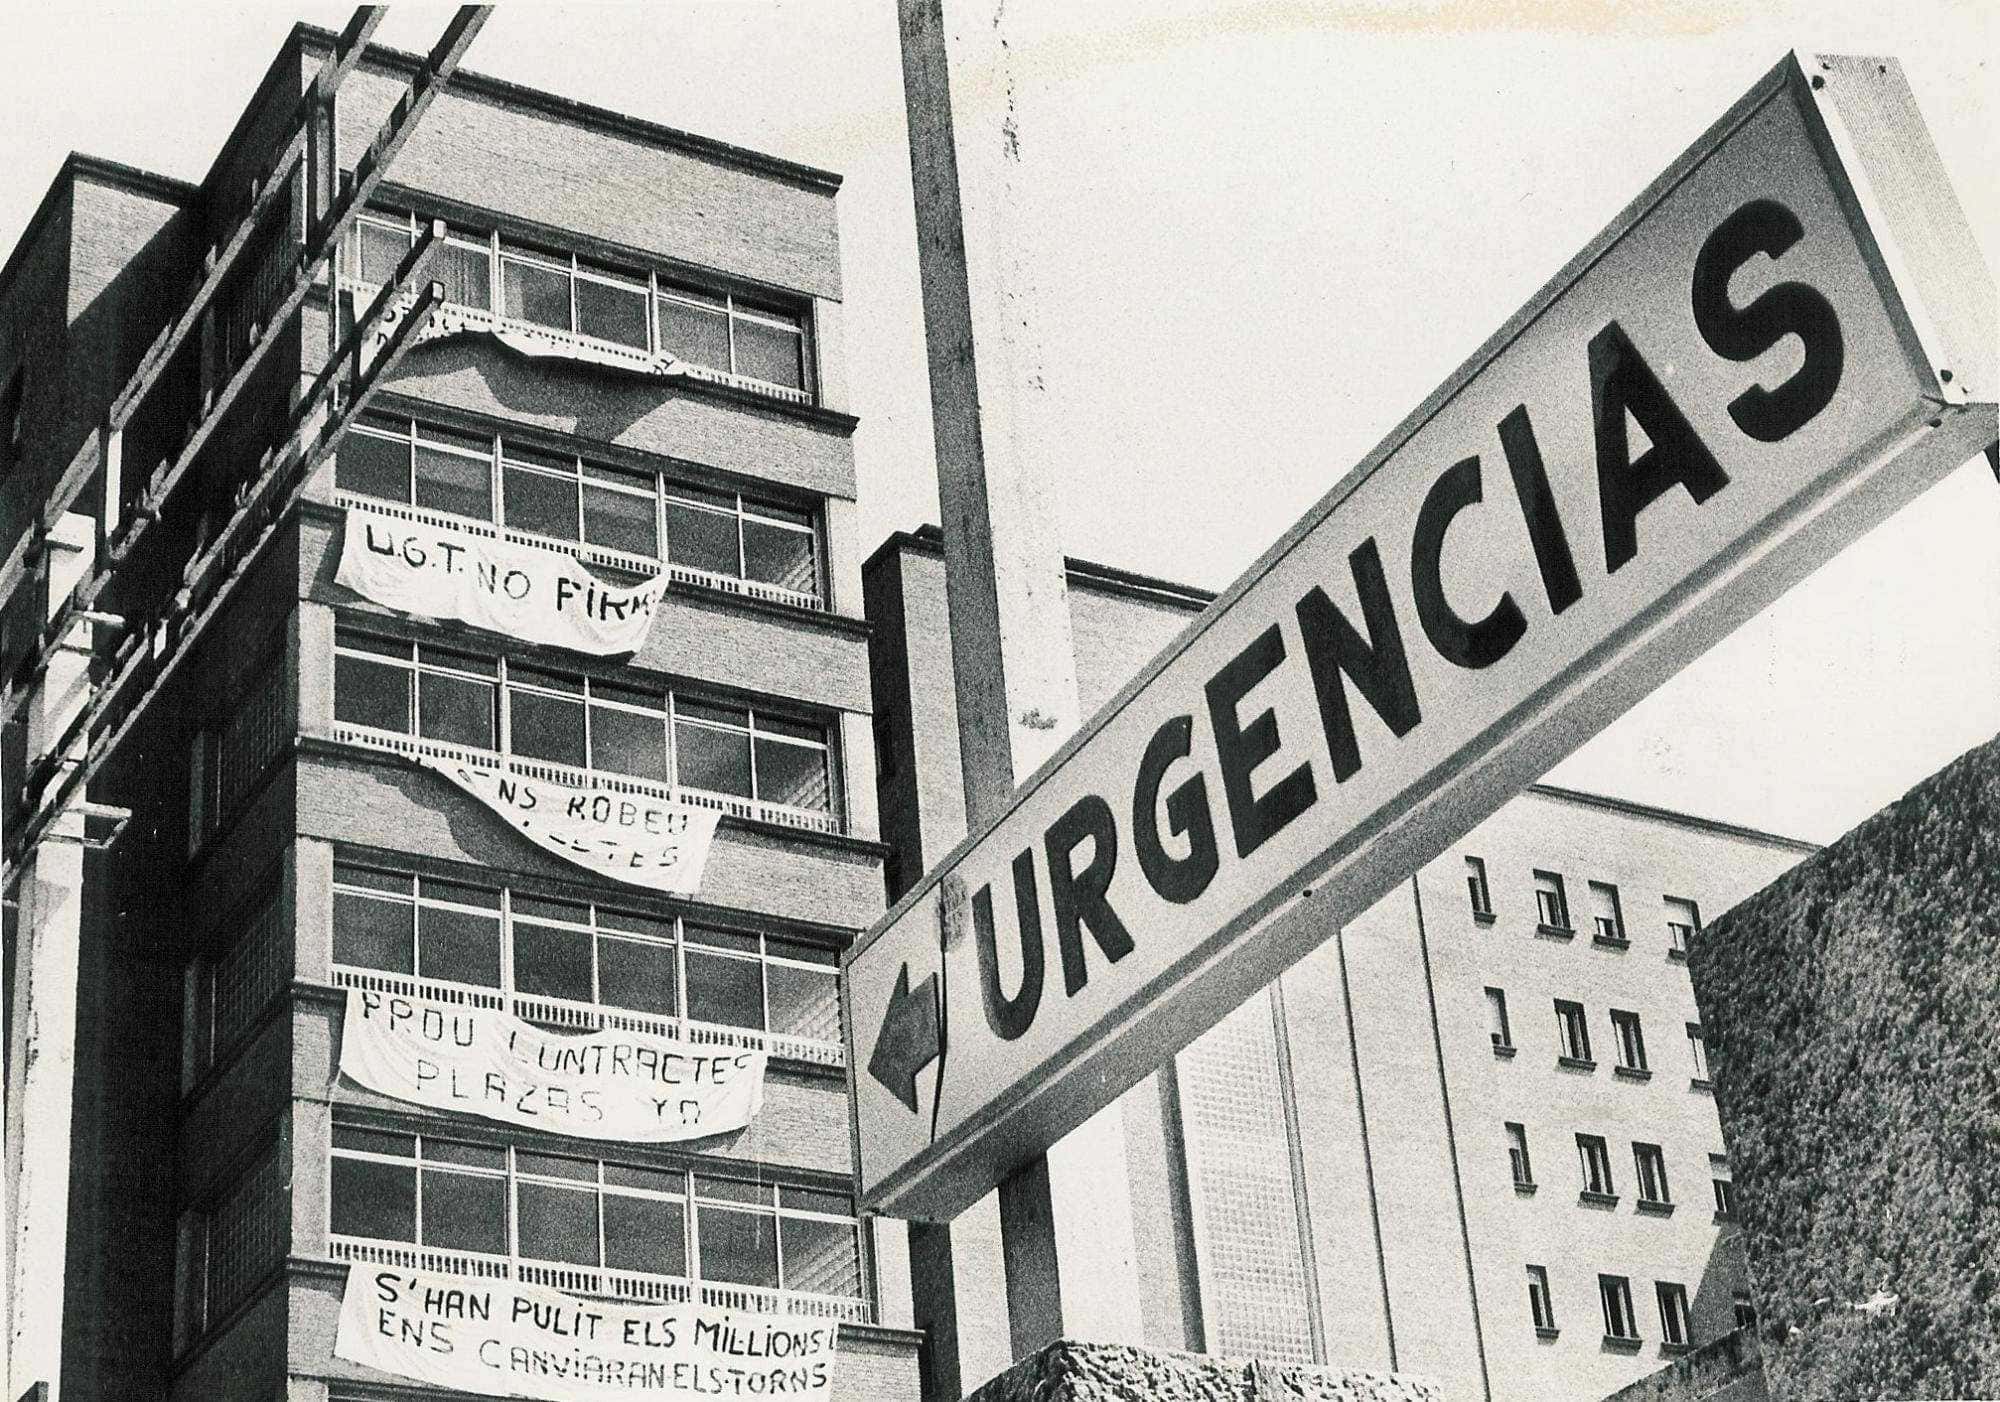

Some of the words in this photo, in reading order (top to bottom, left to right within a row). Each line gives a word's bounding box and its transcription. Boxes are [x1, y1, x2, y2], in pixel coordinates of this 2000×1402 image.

[365, 524, 464, 573] U.G.T.
[478, 561, 531, 600] NO
[969, 199, 1845, 1042] URGENCIAS
[362, 991, 474, 1047] PROU
[417, 1058, 603, 1122] PLAZAS
[652, 1097, 701, 1125] YA
[375, 1272, 491, 1321] S'HAN
[623, 1317, 677, 1348] ELS
[379, 1307, 454, 1354] ENS
